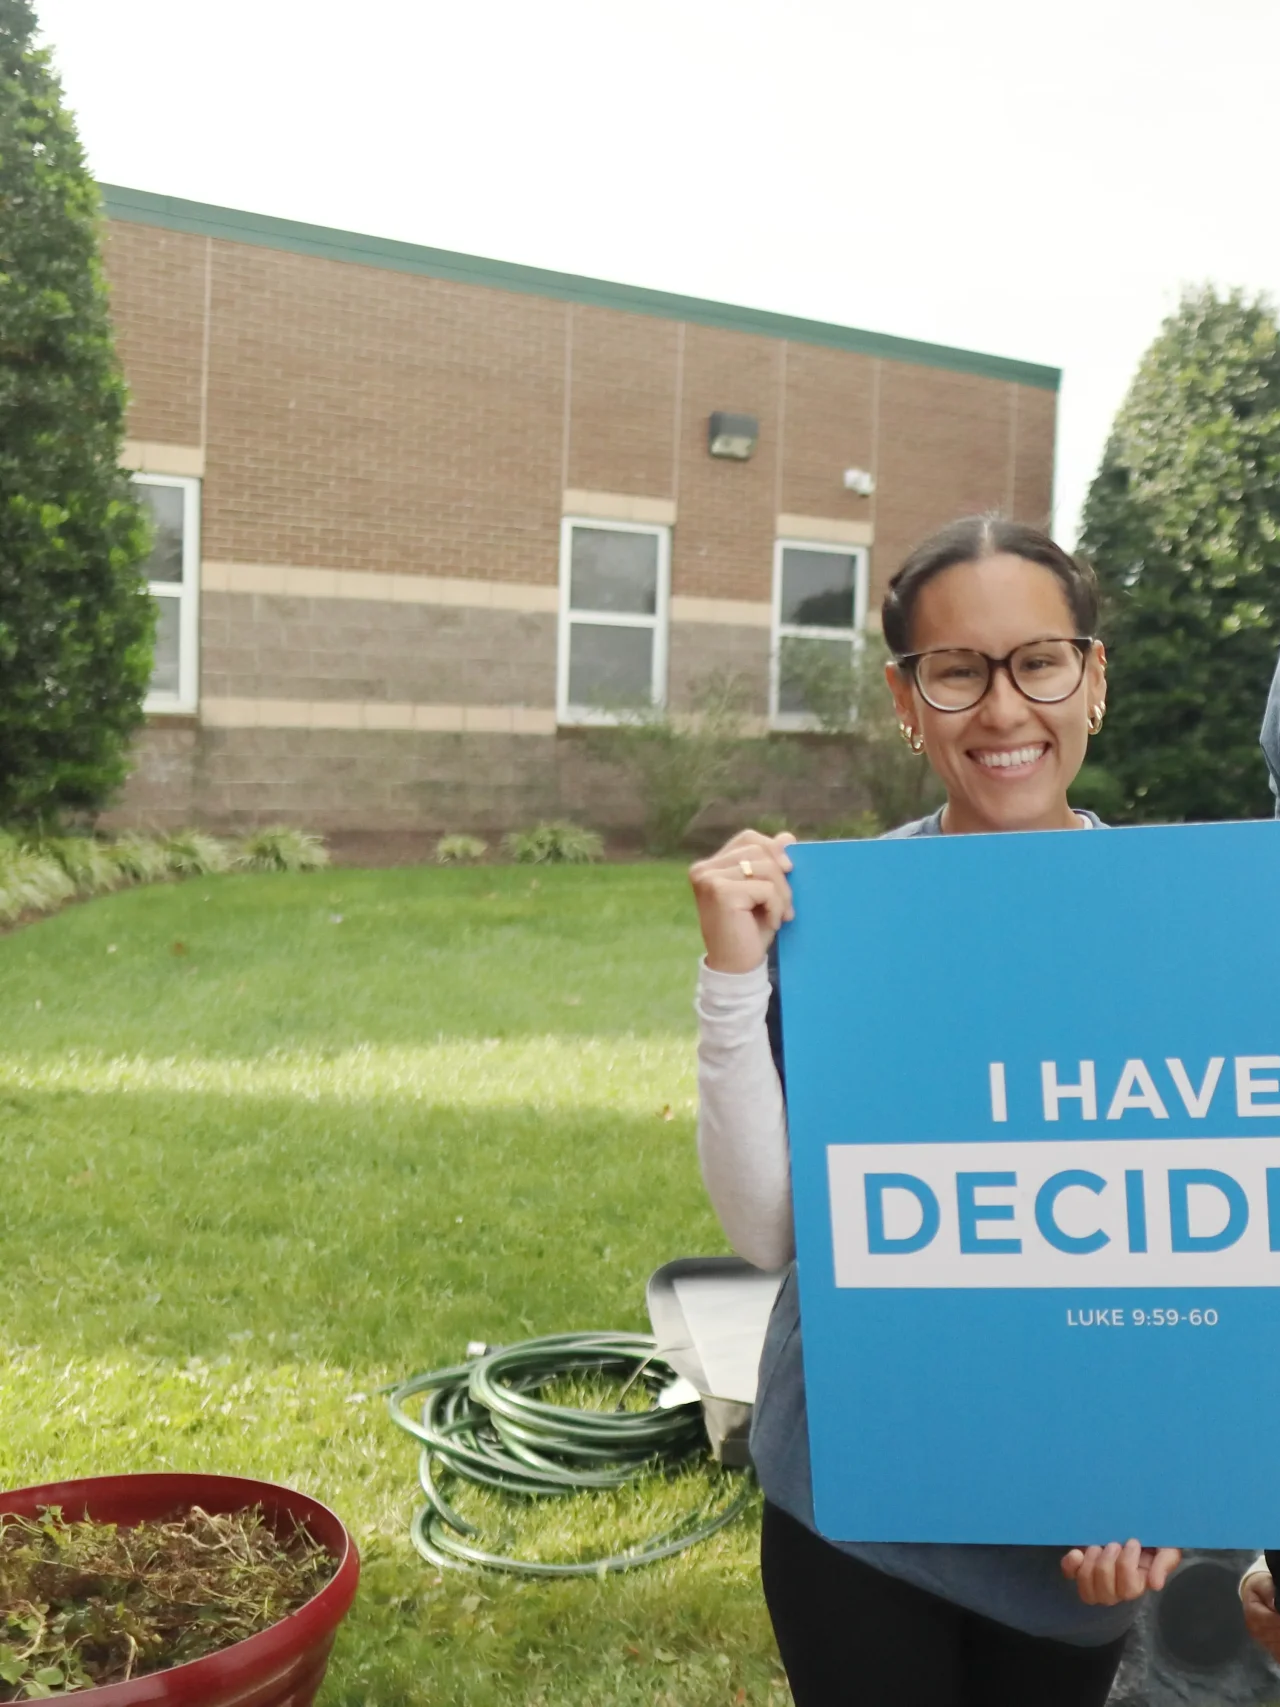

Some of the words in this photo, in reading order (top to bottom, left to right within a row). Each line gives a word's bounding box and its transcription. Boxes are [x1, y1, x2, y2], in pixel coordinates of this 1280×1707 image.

[989, 1061, 1007, 1122] I
[1066, 1308, 1125, 1327] LUKE
[1132, 1307, 1219, 1327] 9:59-60
